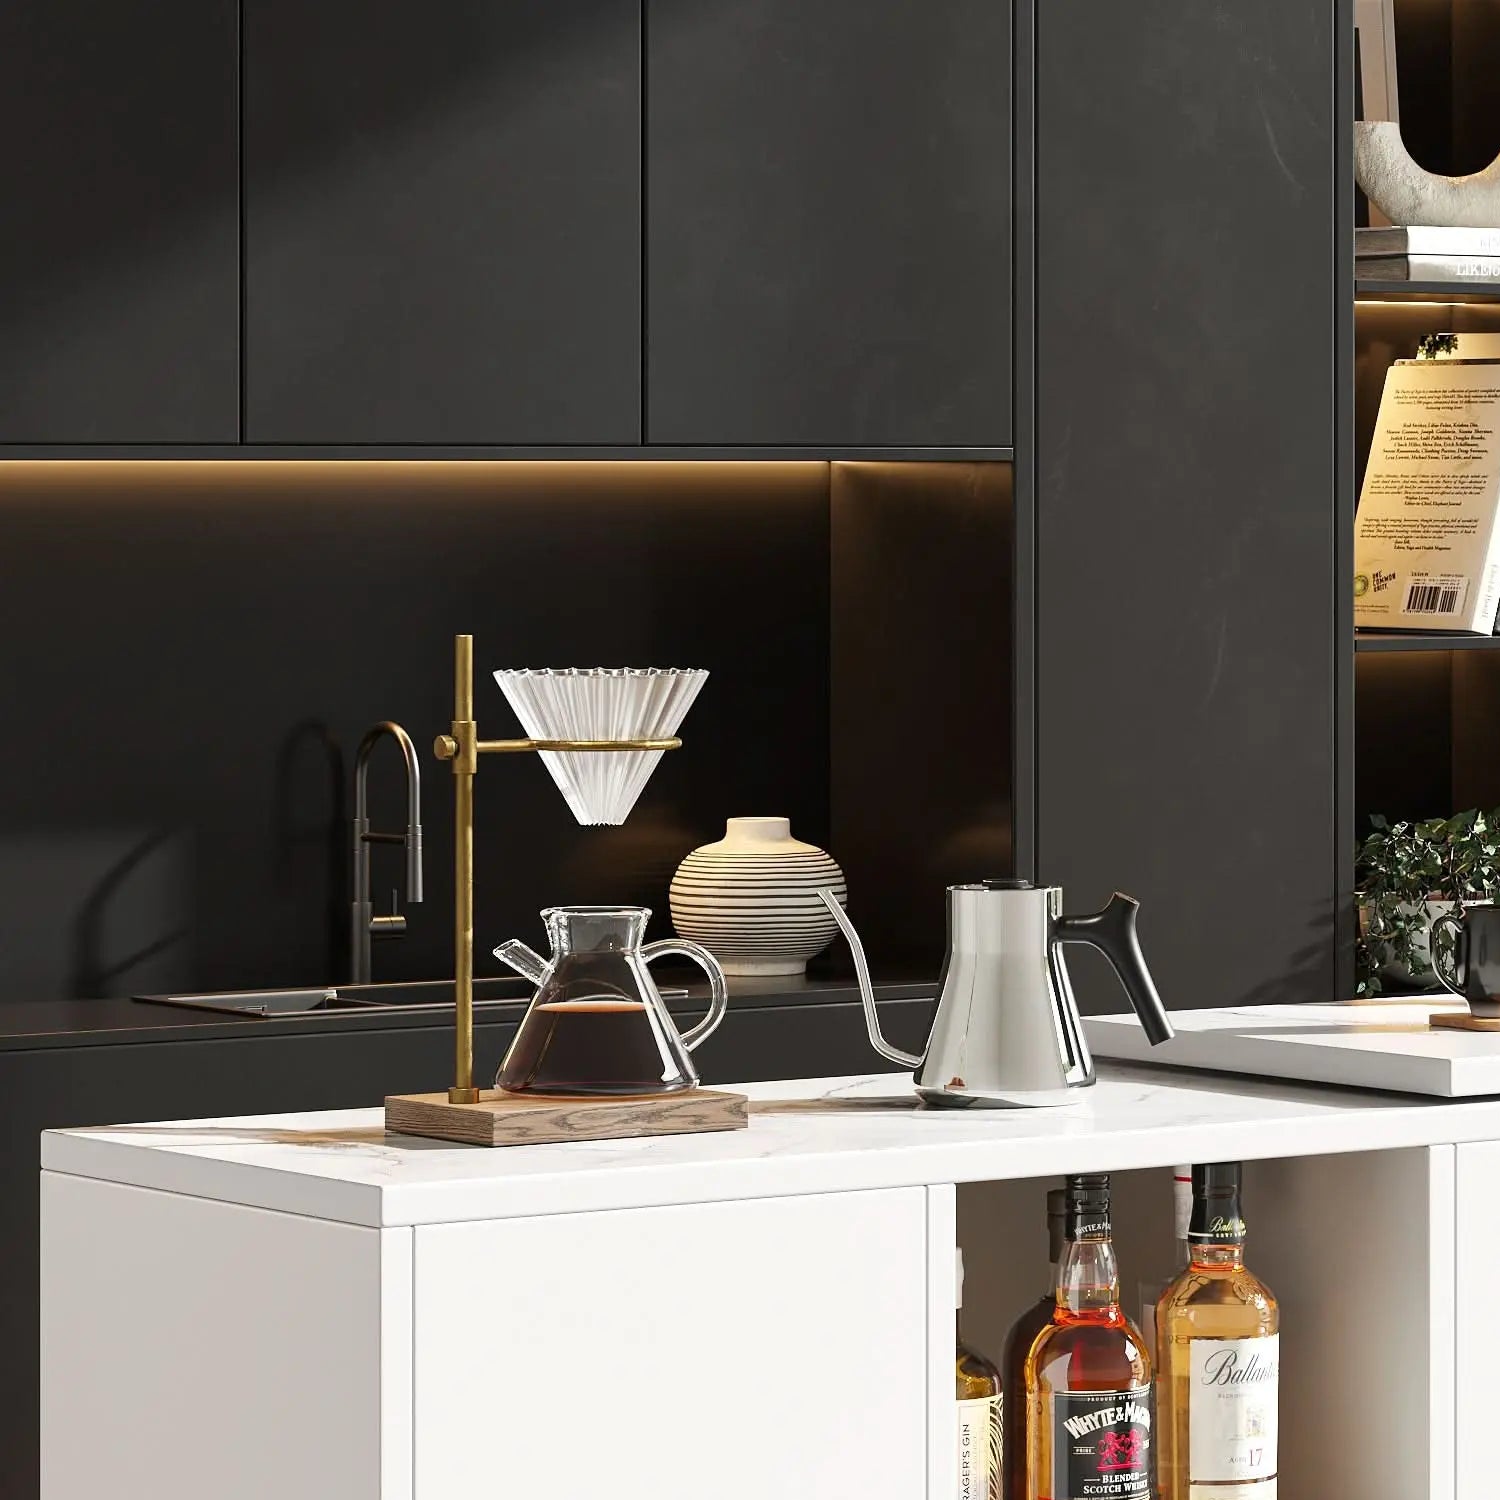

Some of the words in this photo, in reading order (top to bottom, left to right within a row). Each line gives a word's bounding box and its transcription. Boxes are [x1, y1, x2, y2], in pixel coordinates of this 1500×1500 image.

[962, 1424, 970, 1446] GIN
[1249, 1447, 1263, 1467] 17
[1102, 1472, 1140, 1484] BLENDED
[1083, 1484, 1122, 1494] SCOTCH
